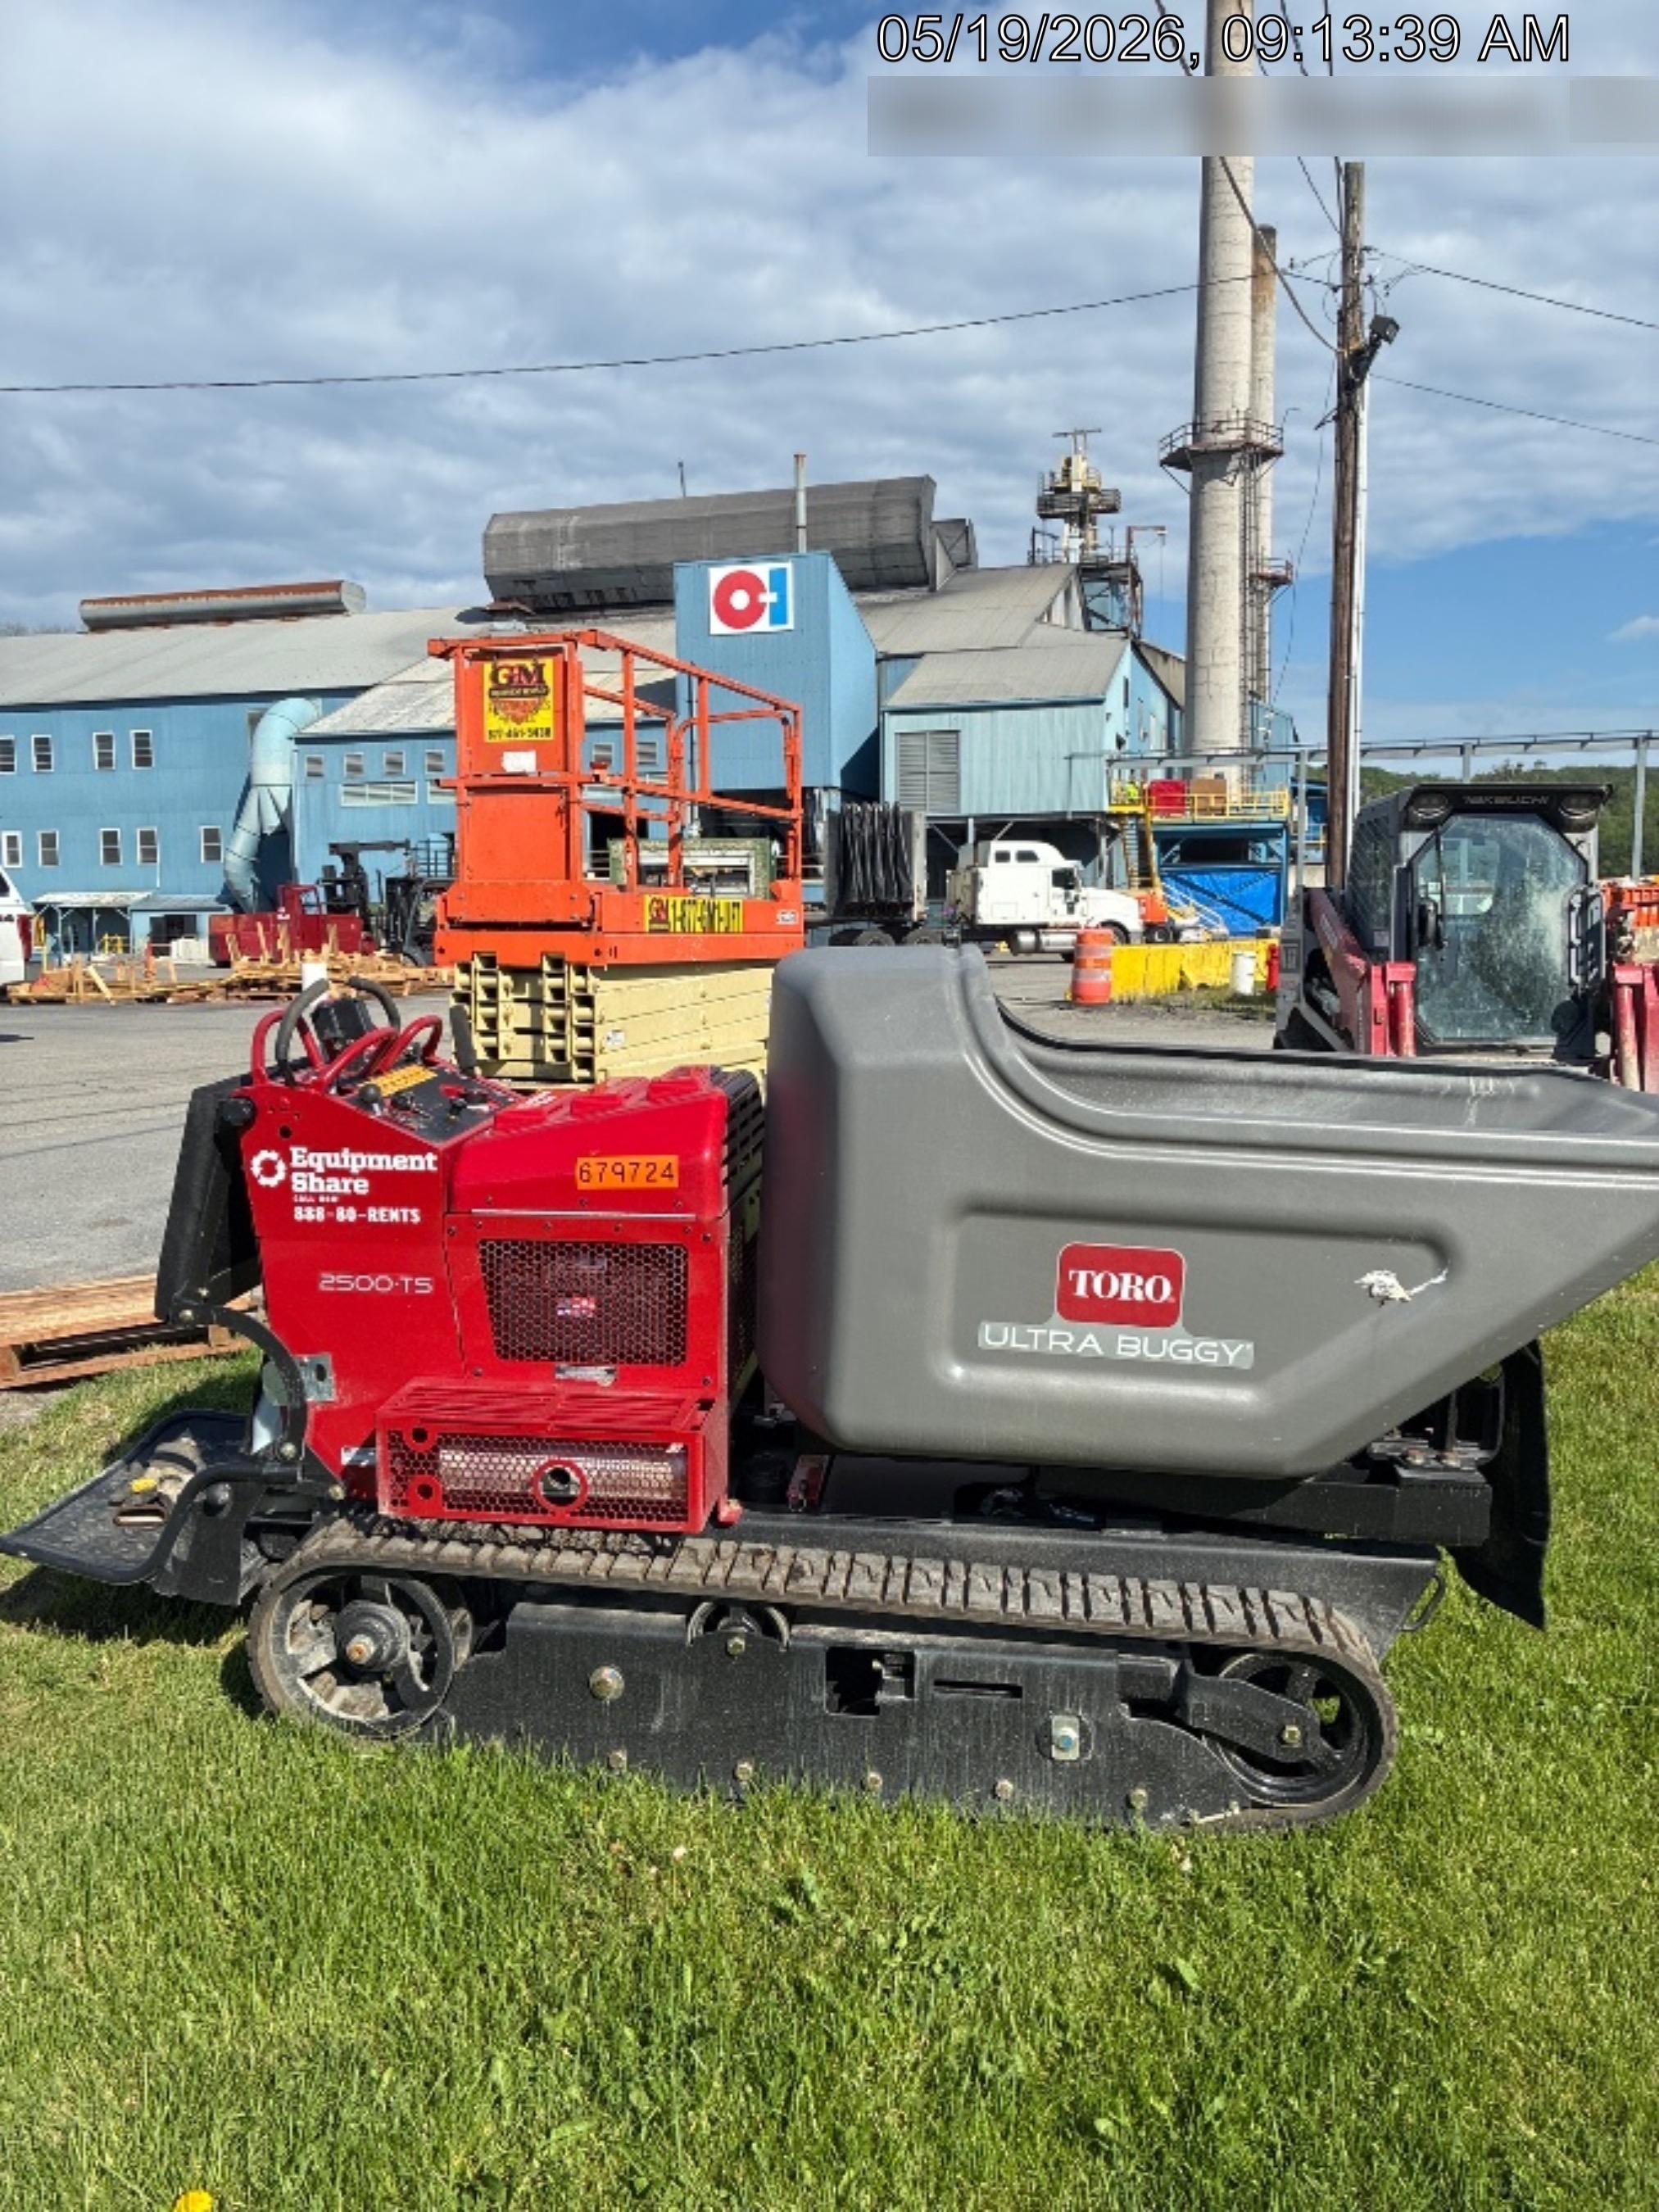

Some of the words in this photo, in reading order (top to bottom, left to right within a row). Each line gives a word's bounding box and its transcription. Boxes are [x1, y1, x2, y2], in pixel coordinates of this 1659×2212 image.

[289, 1147, 438, 1173] Equipment
[579, 1162, 674, 1183] 679724
[291, 1172, 369, 1195] Share
[1069, 1269, 1173, 1303] TORO
[984, 1323, 1104, 1355] ULTRA
[1117, 1335, 1244, 1365] BUGGY
